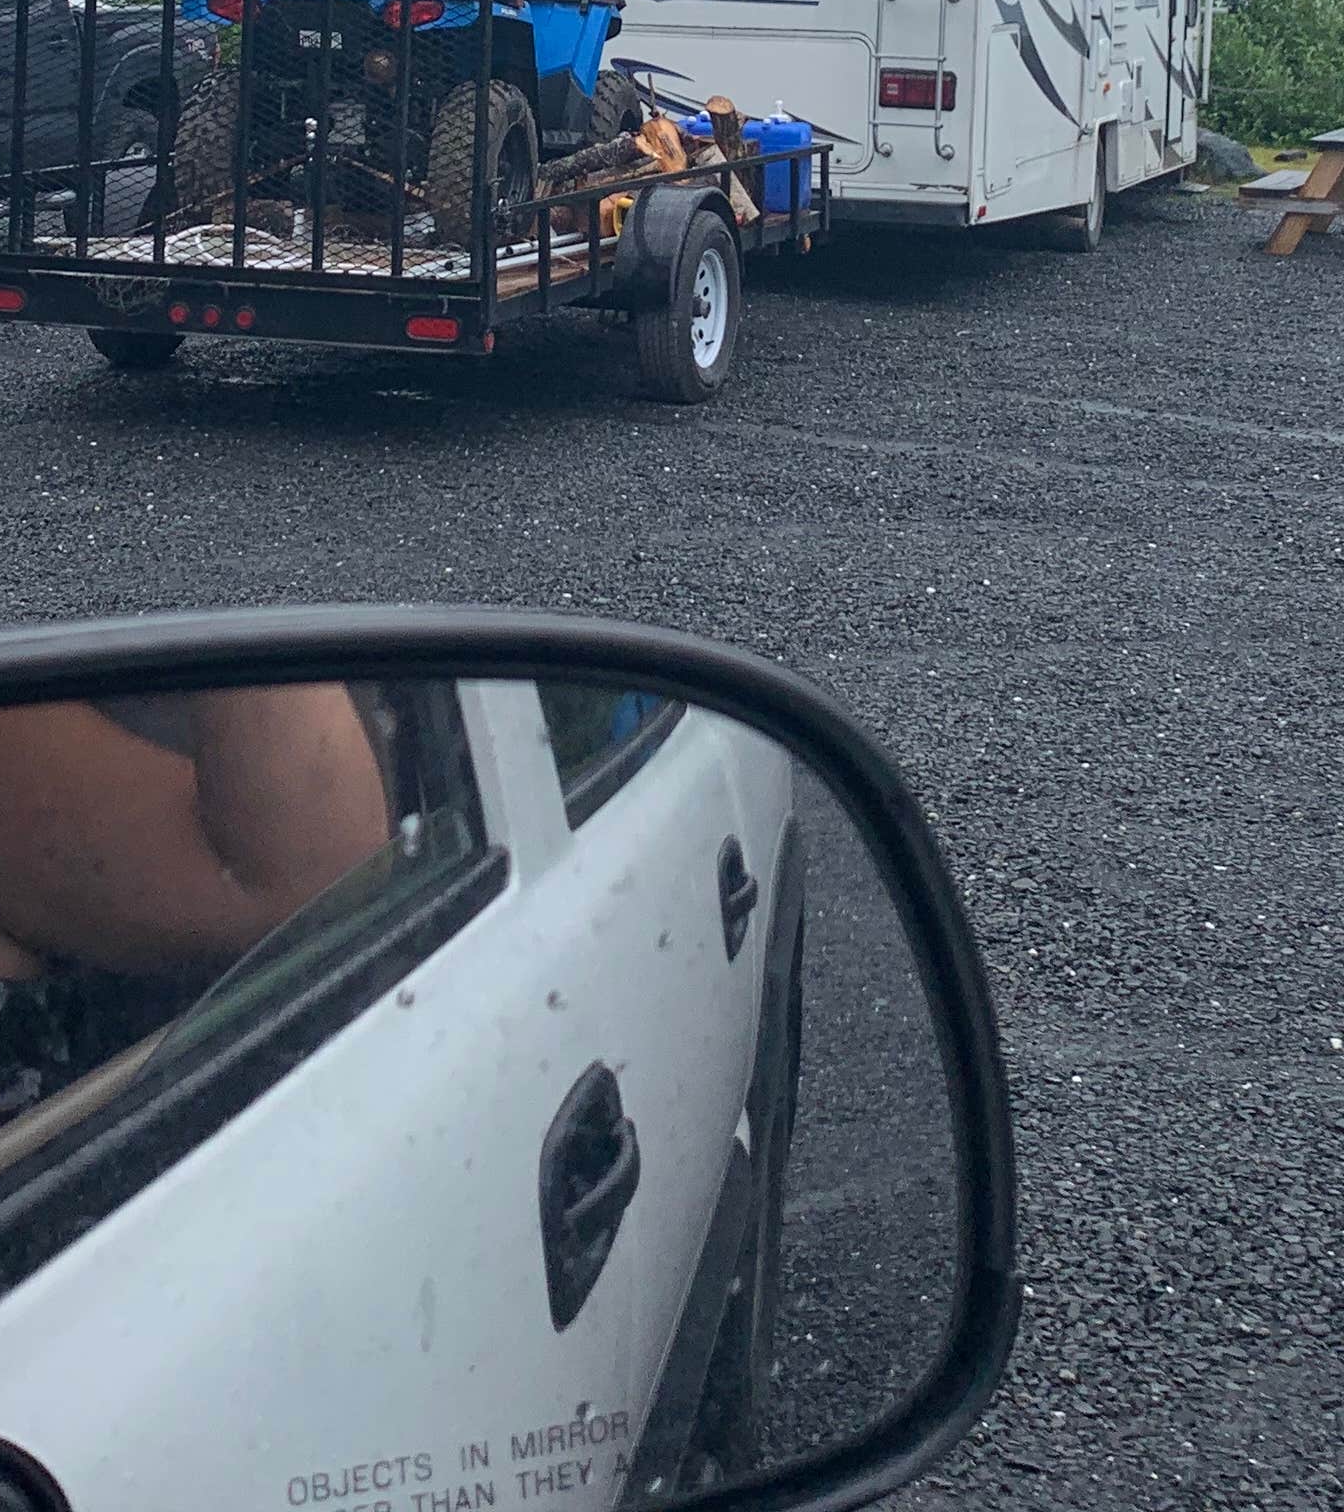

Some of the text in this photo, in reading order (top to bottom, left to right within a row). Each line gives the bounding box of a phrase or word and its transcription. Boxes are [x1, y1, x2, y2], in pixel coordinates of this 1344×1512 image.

[286, 1410, 631, 1507] OBJECTS IN MIRROR
[410, 1479, 497, 1512] THAN
[514, 1456, 594, 1501] THEY
